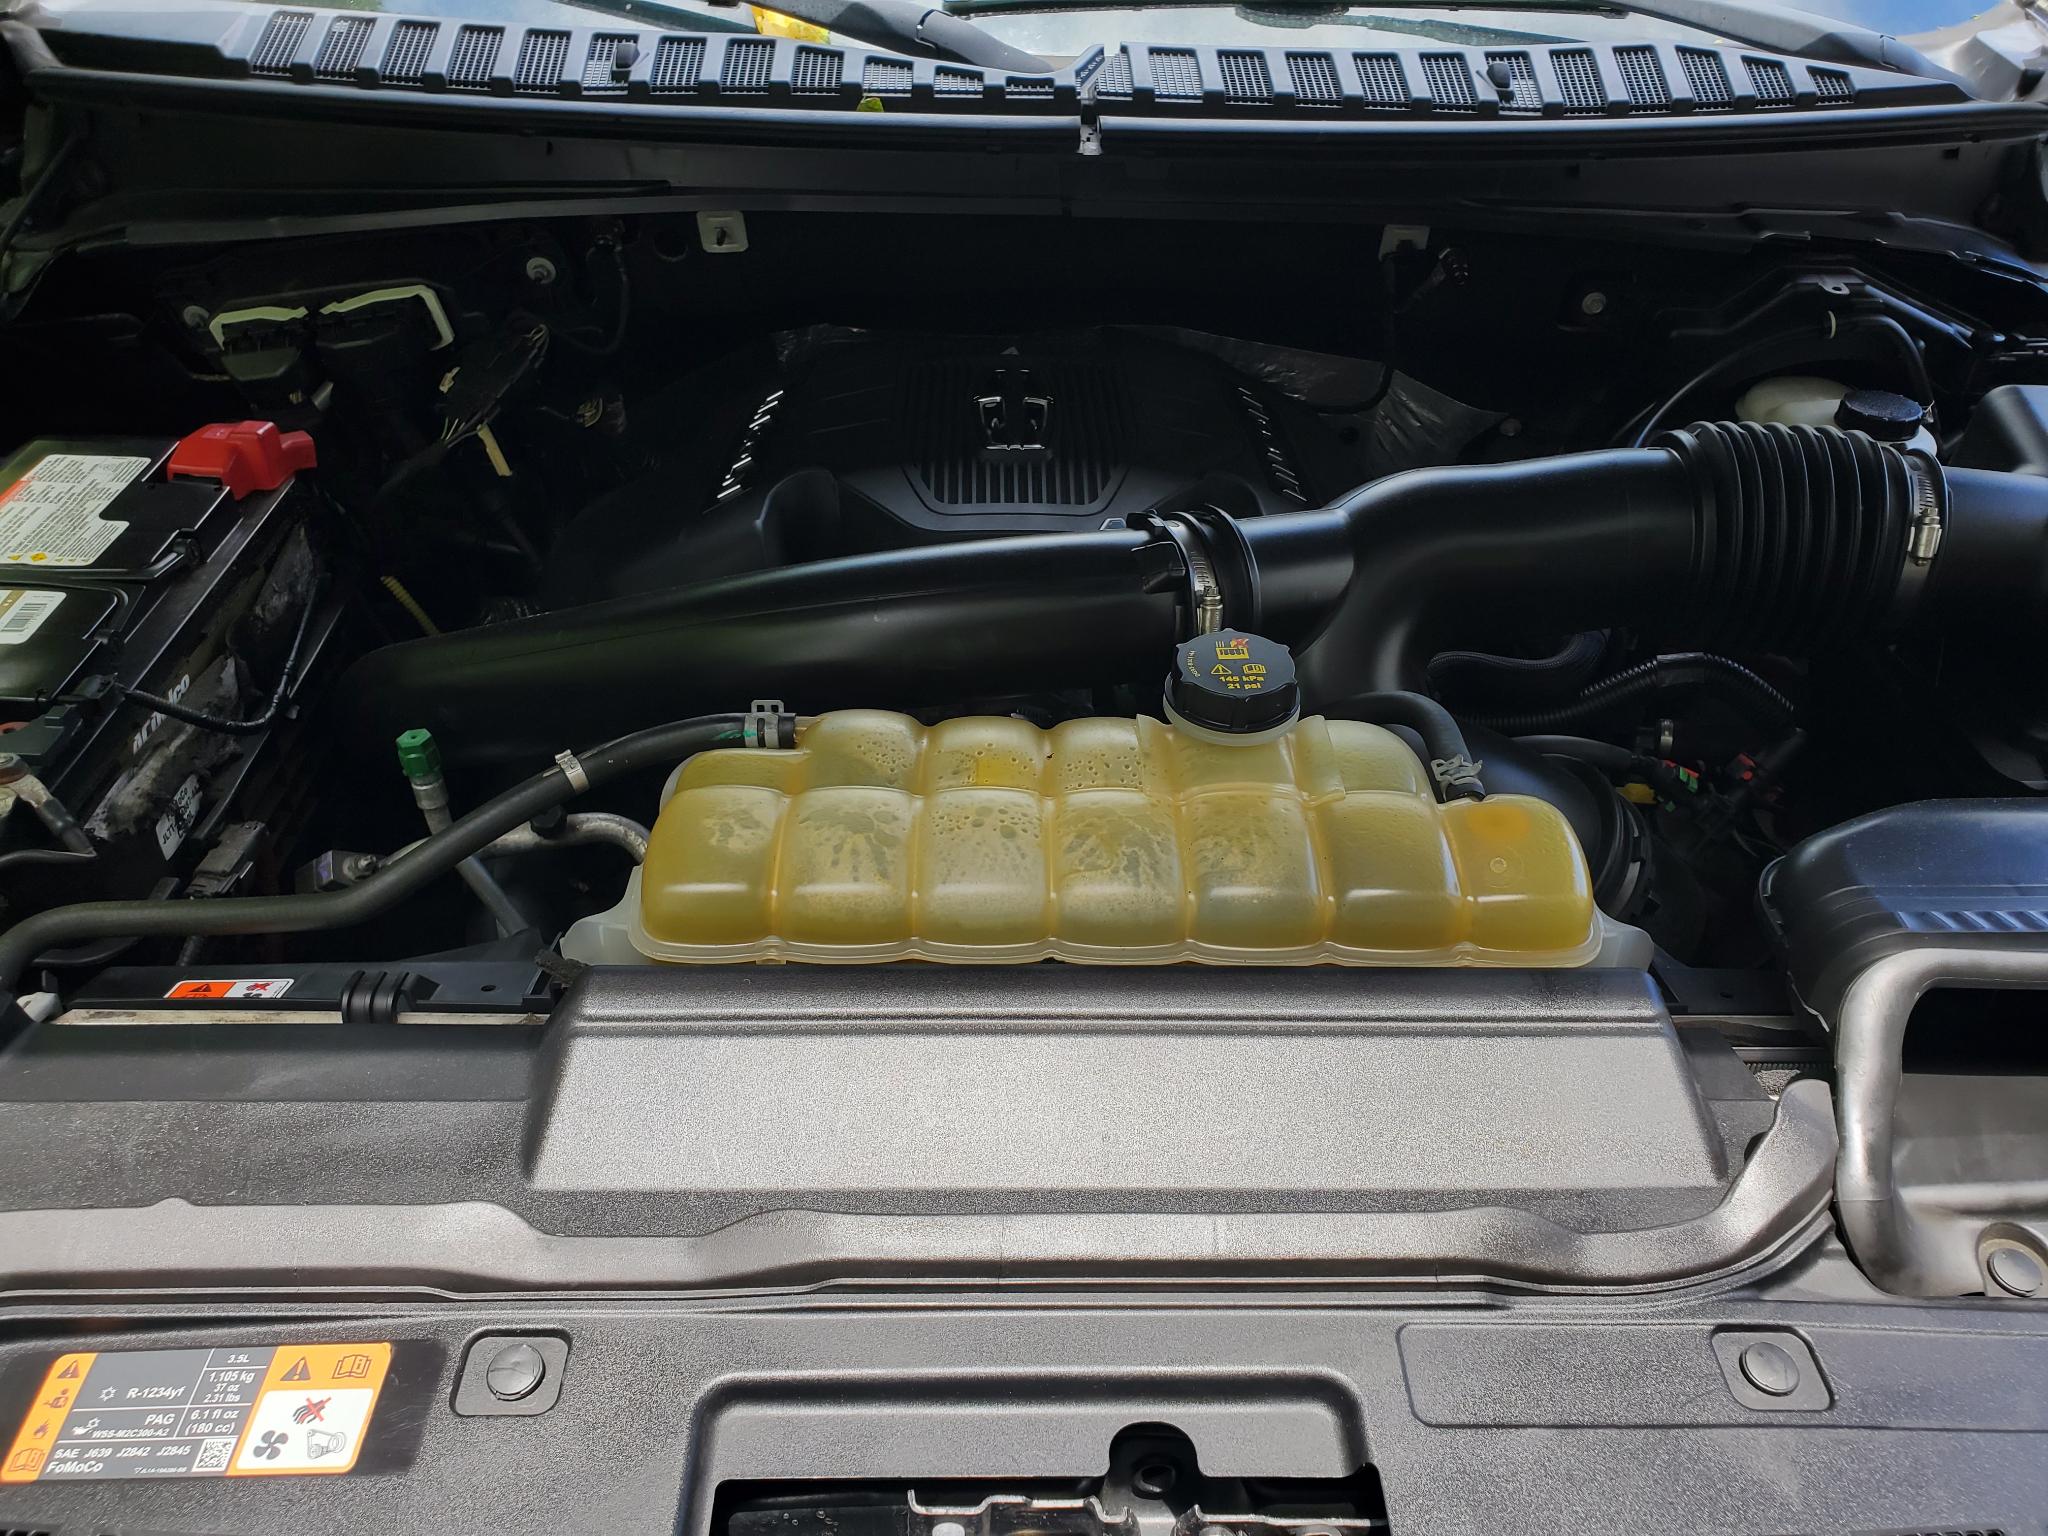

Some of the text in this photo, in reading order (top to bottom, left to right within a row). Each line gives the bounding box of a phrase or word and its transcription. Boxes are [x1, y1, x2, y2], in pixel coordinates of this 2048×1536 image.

[227, 1353, 250, 1364] 3.5L
[208, 1370, 255, 1384] 1.105 kg
[126, 1385, 187, 1400] R-1234yf
[213, 1383, 240, 1393] 37 oz
[203, 1393, 241, 1404] 2.31 lbs
[144, 1413, 176, 1426] PAG
[190, 1408, 241, 1421] 6.1 fl oz
[184, 1422, 236, 1436] (180 cc)
[54, 1445, 192, 1459] SAE J639 J2842 J2845
[46, 1460, 104, 1474] FoMoCo
